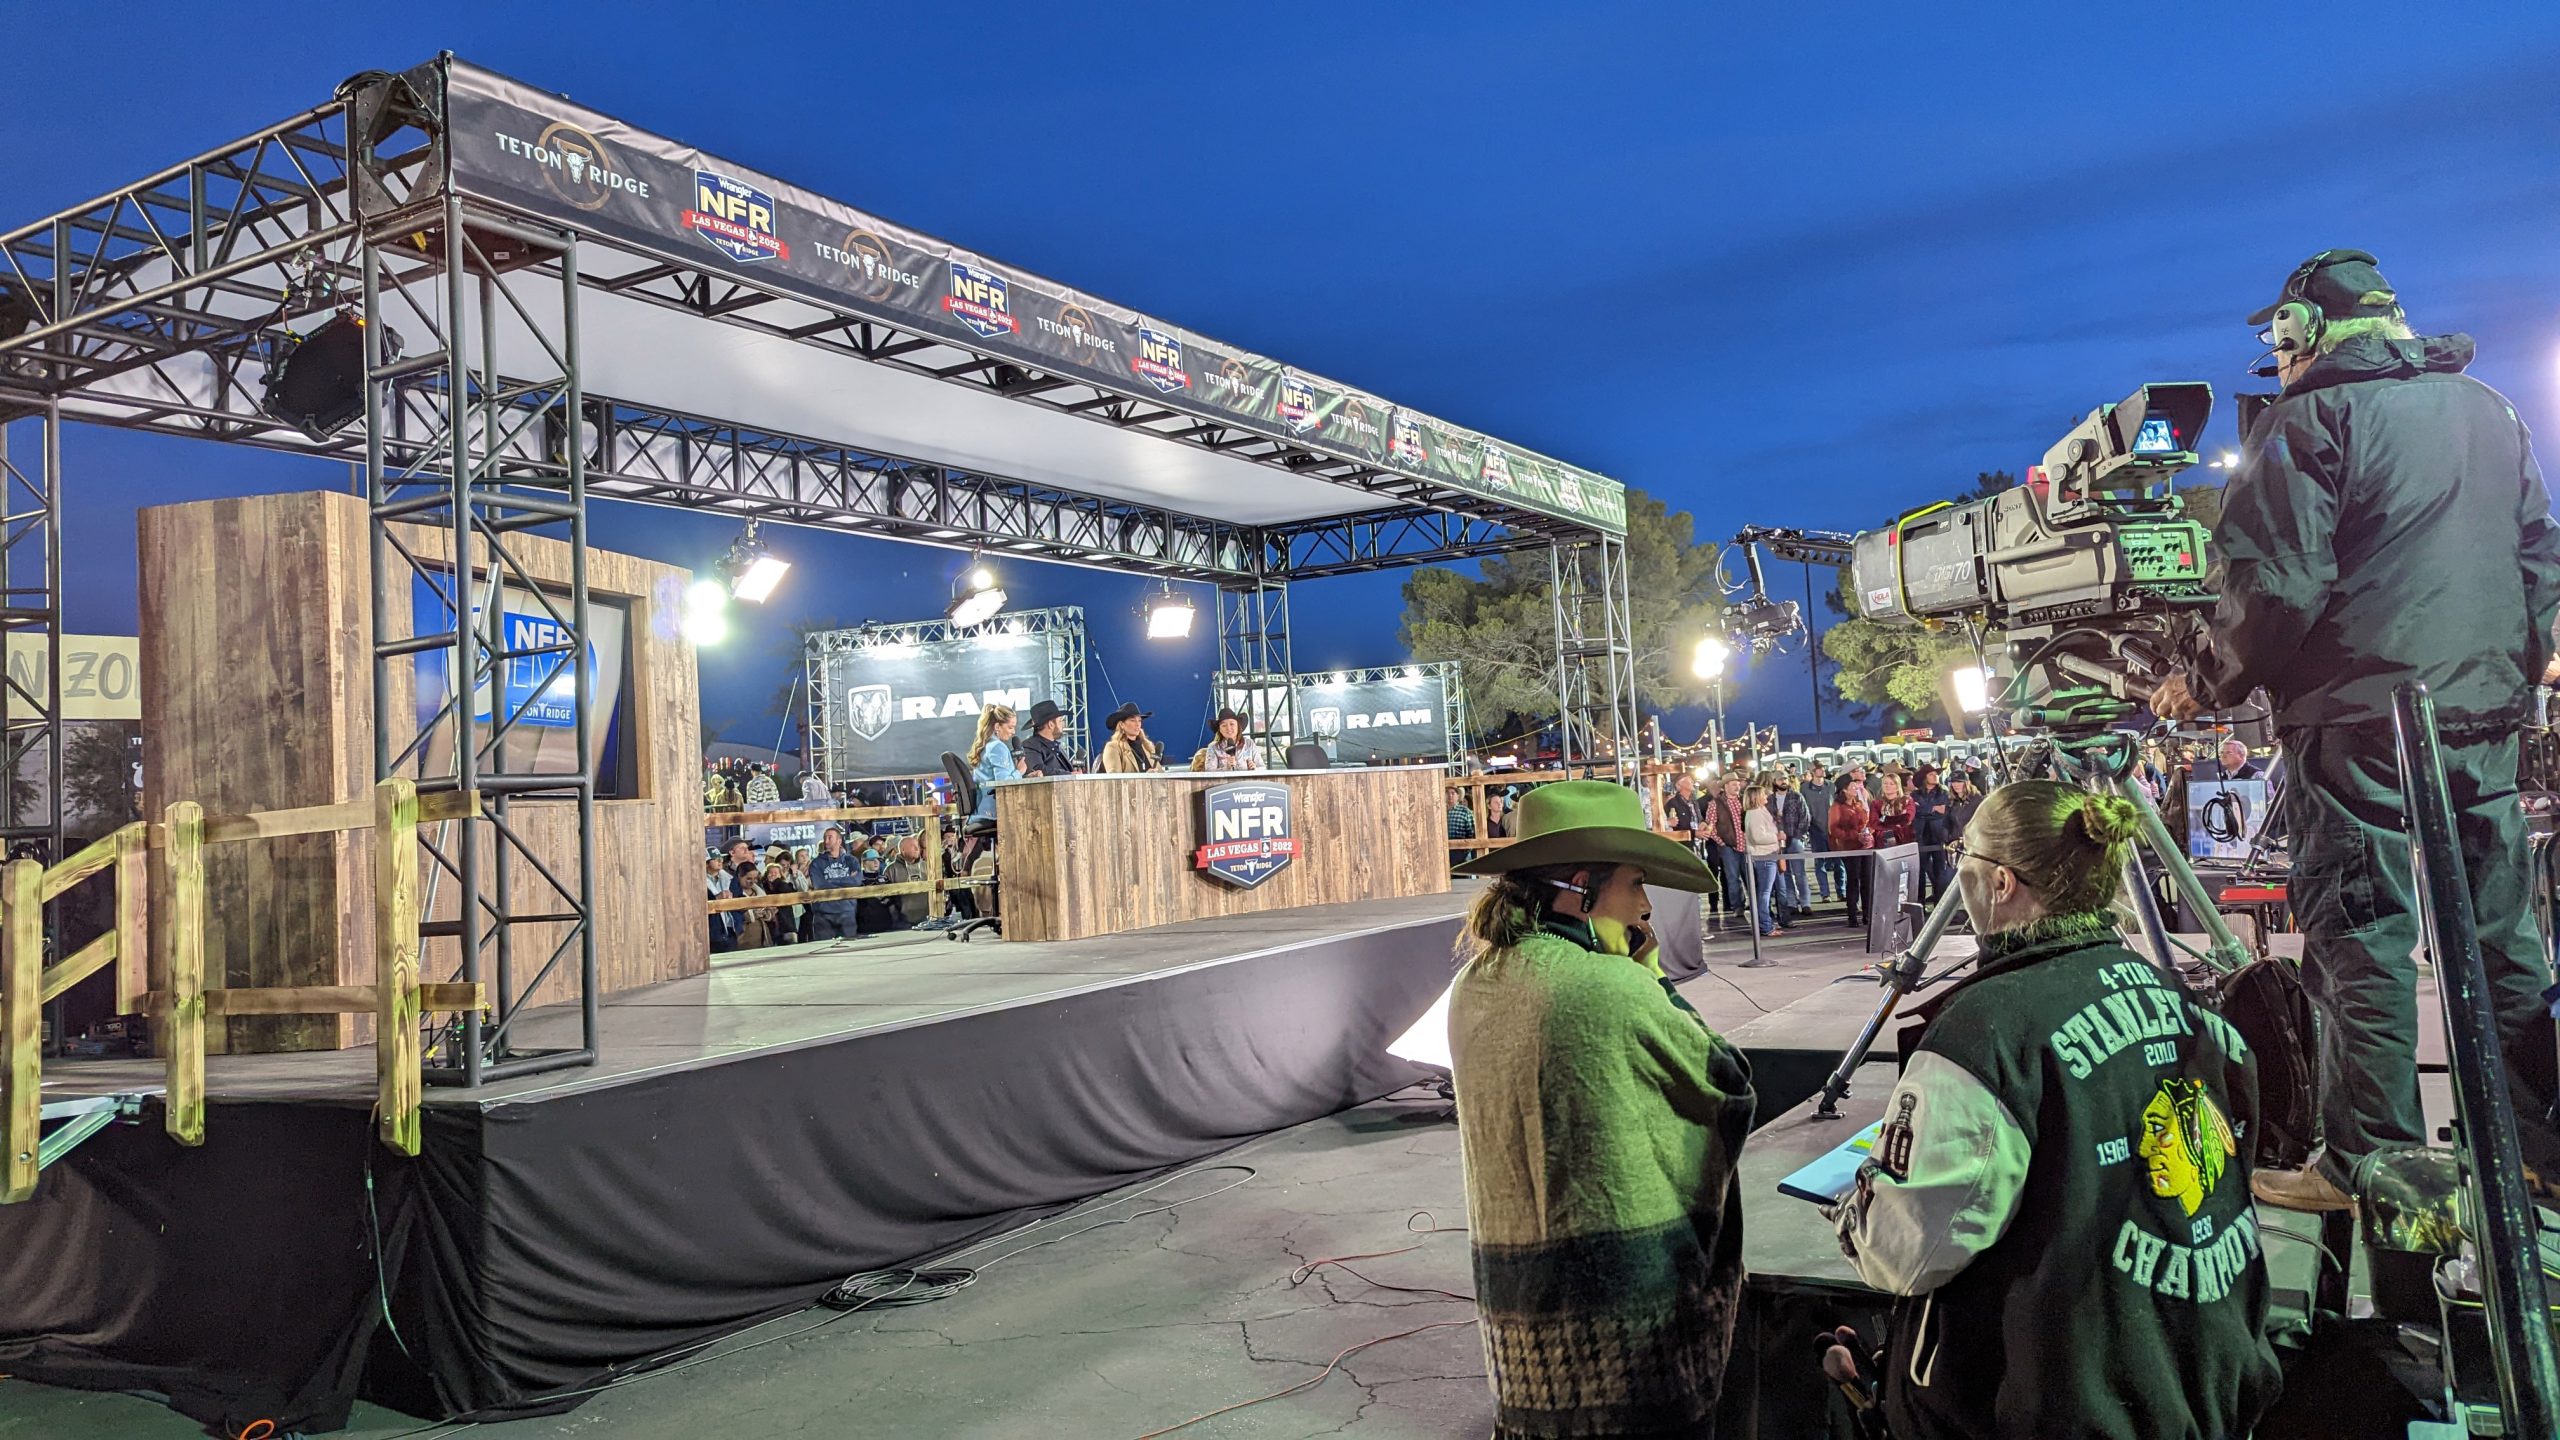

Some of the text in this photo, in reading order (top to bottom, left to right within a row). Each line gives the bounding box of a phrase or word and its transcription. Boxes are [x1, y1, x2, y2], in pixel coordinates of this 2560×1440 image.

[495, 132, 650, 198] TETON RIDGE
[718, 178, 753, 198] Wrangler
[700, 185, 771, 234] NFR
[692, 214, 781, 250] LAS VEGAS 2022
[715, 237, 733, 248] TETON
[814, 241, 920, 288] TETON RIDGE
[966, 266, 992, 283] Wrangler
[954, 274, 1006, 312] NFR
[949, 299, 964, 310] LAS
[964, 303, 988, 317] VEGAS
[1036, 316, 1116, 353] TETON RIDGE
[1142, 338, 1180, 370] NFR
[1204, 371, 1265, 400] TETON RIDGE
[1283, 386, 1314, 411] NFR
[1330, 413, 1380, 437] TETON RIDGE
[1396, 423, 1420, 446] NFR
[1954, 560, 1971, 582] 70
[64, 651, 141, 700] ZO
[512, 704, 572, 720] TON RIDGE
[902, 687, 1031, 721] RAM
[1346, 708, 1432, 730] RAM
[1232, 791, 1267, 807] Wrangler
[769, 825, 816, 841] SELFIE
[1214, 806, 1285, 841] NFR
[1207, 841, 1293, 859] LAS VEGAS 2022
[1230, 865, 1248, 873] TETON
[2050, 987, 2194, 1081] STANLEY
[2144, 1040, 2179, 1067] 2010
[2095, 1136, 2131, 1167] 1961
